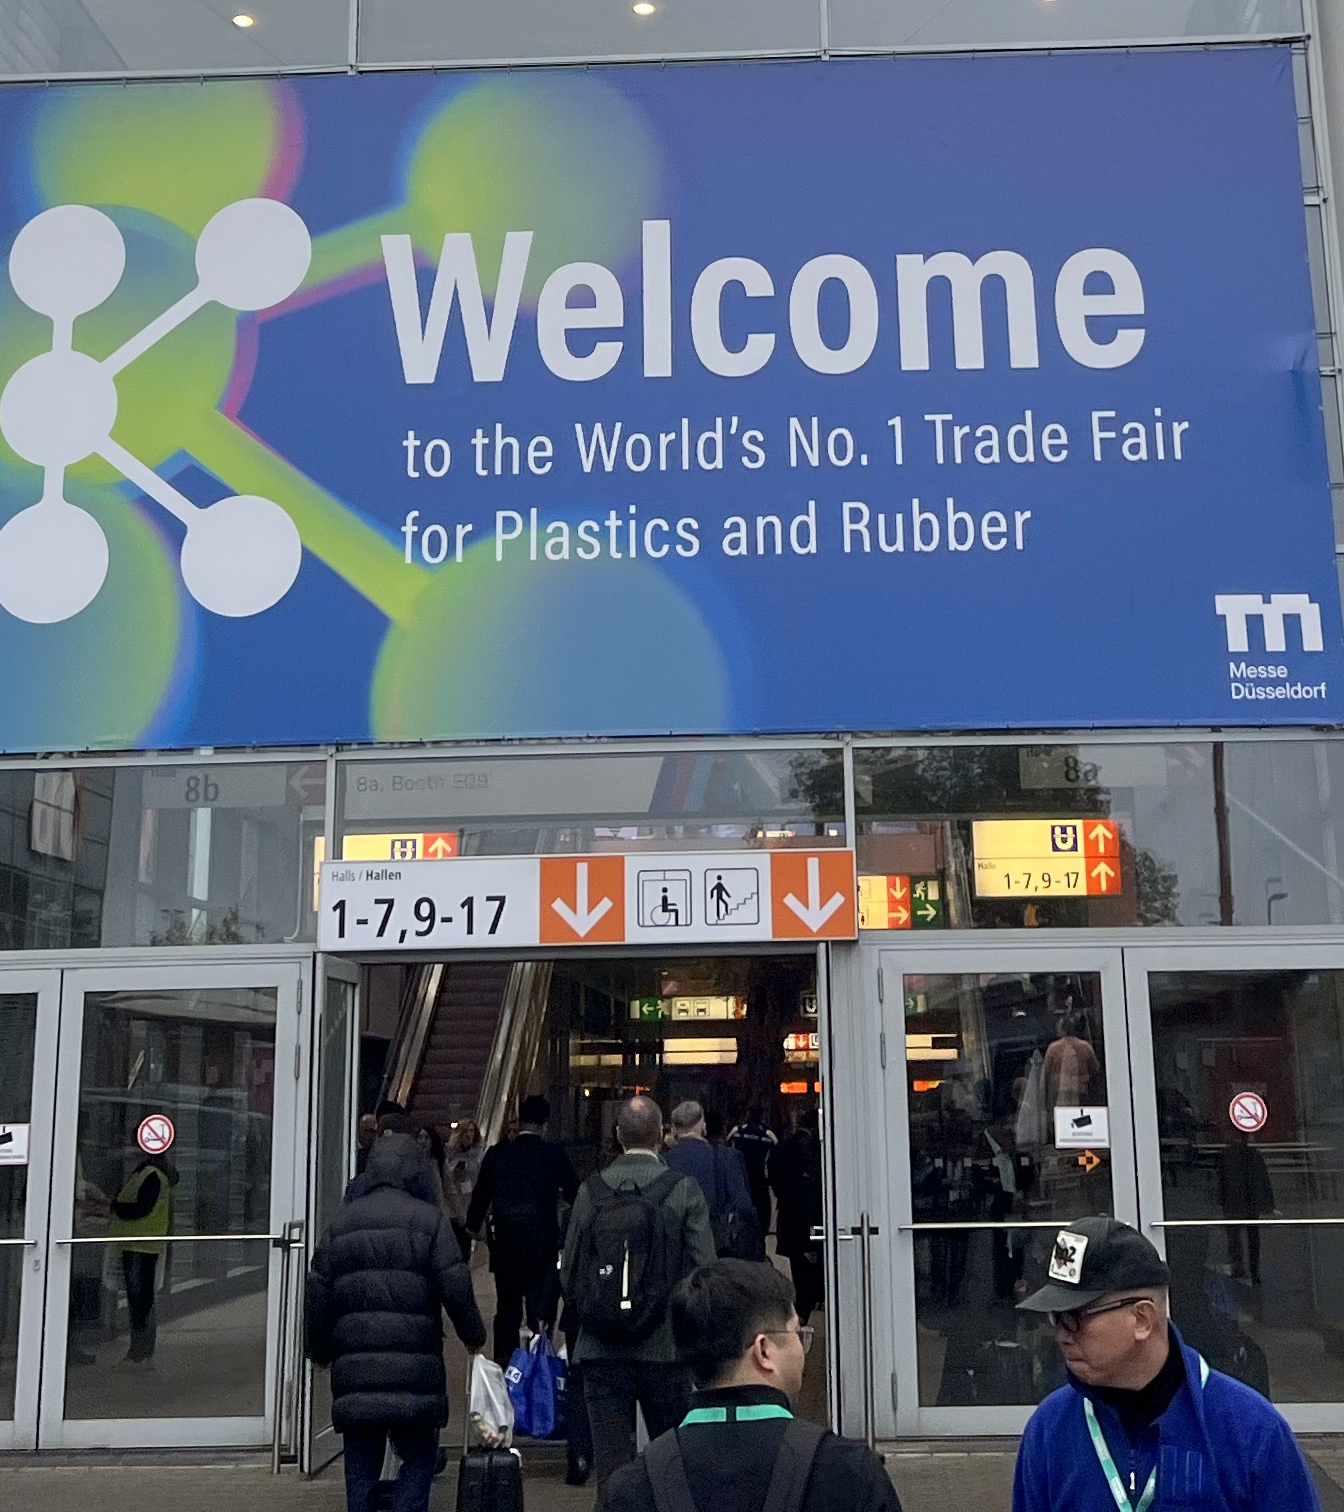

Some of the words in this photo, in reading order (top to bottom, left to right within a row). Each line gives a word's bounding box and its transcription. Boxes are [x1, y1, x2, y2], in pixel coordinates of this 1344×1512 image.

[378, 218, 1146, 385] Welcome
[402, 430, 452, 479] to
[471, 423, 554, 476] the
[573, 415, 767, 474] World's
[789, 416, 869, 468] No.
[887, 416, 904, 465] 1
[924, 410, 1069, 464] Trade
[1091, 410, 1190, 462] Fair
[402, 510, 474, 565] for
[494, 508, 700, 563] Plastics
[722, 500, 818, 556] and
[843, 497, 1032, 553] Rubber
[1228, 661, 1289, 679] Messe
[1230, 681, 1327, 700] Düsseldorf
[391, 774, 447, 792] Booth
[1063, 754, 1100, 783] 8a
[184, 773, 220, 804] 8b
[331, 870, 356, 882] Halls
[365, 869, 402, 881] Hallen
[331, 895, 507, 944] 1-7,9-17
